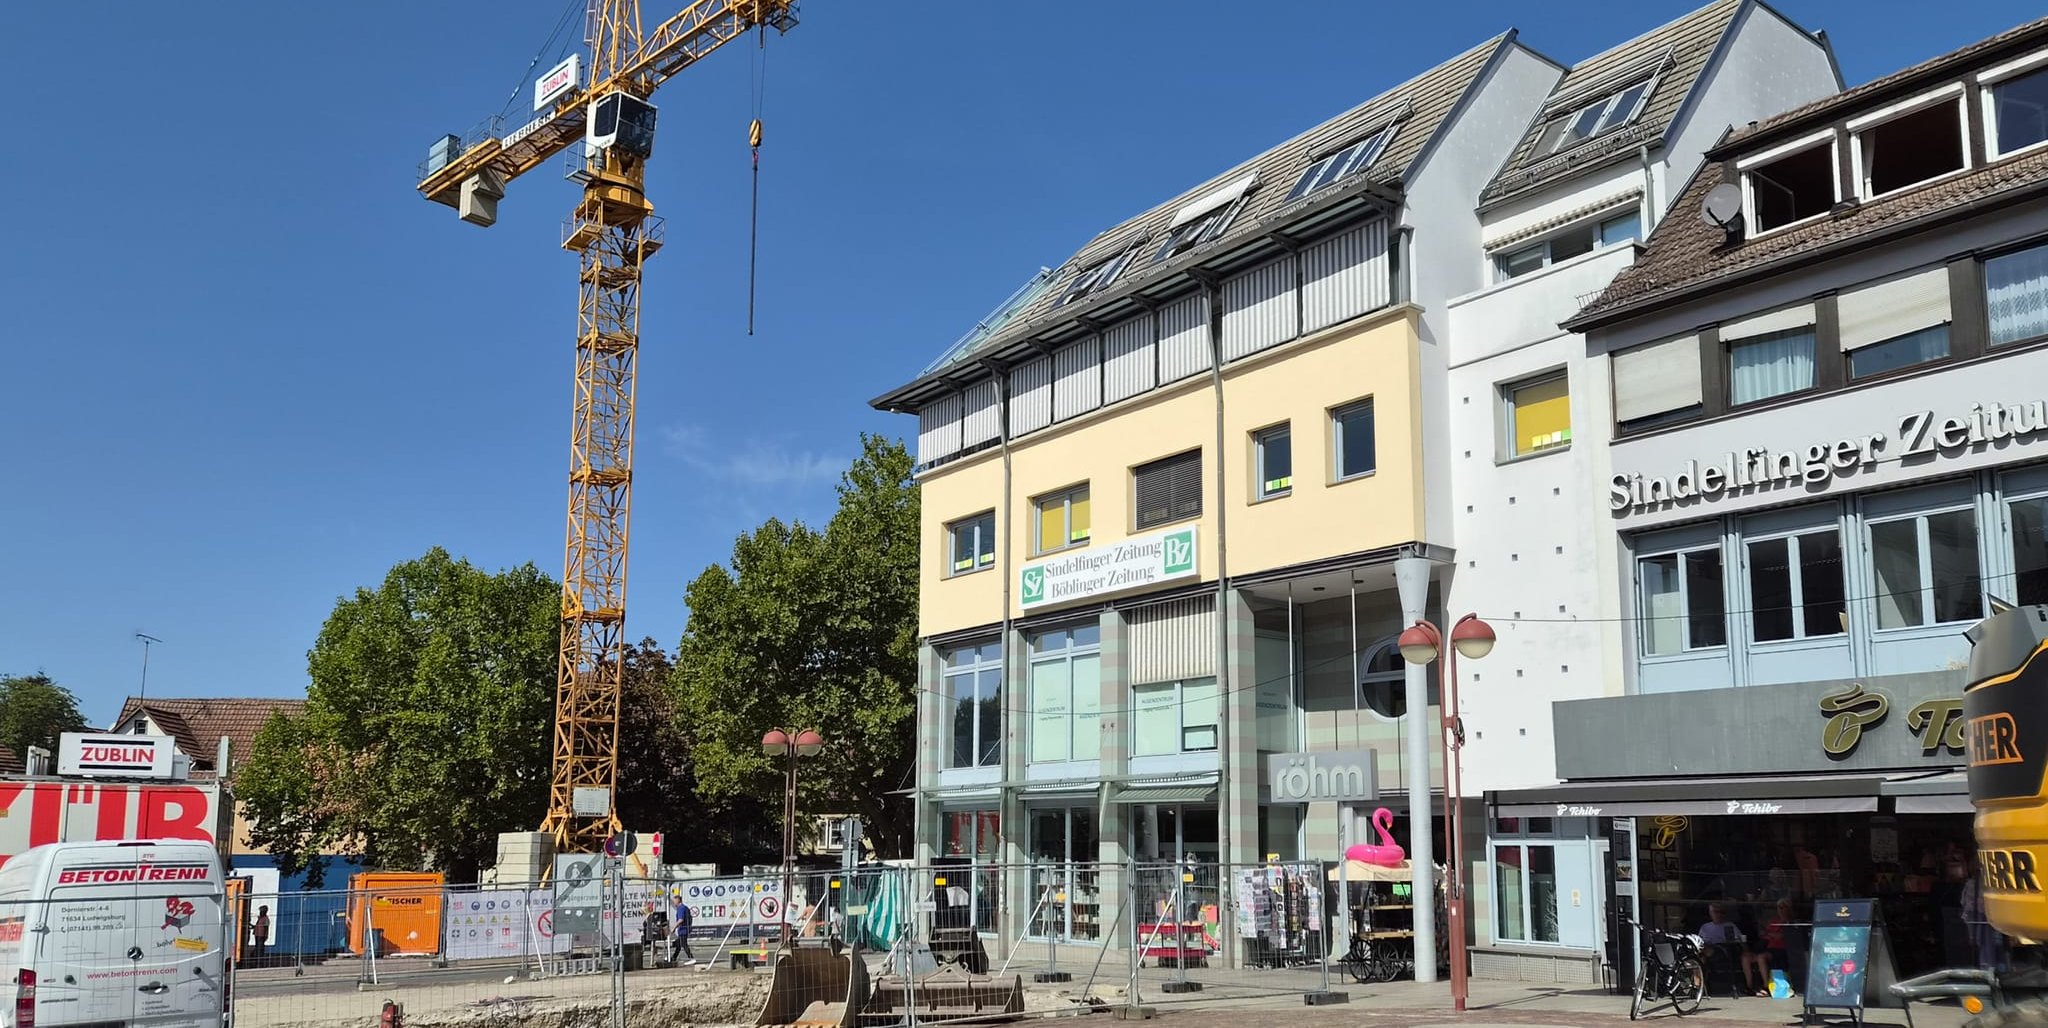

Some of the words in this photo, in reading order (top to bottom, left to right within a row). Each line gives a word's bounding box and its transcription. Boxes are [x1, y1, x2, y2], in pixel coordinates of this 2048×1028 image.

[1609, 432, 1887, 512] Sindelfinger
[1045, 553, 1113, 579] Sindelfinger
[1115, 541, 1162, 564] Zeitung
[1052, 574, 1105, 598] Böblinger
[1108, 567, 1155, 587] Zeitung
[80, 746, 155, 763] ZÜBLIN
[1276, 755, 1365, 799] röhm
[1569, 805, 1602, 816] Tchibo
[1741, 802, 1783, 814] Tchibo
[58, 864, 209, 884] BETONTRENN
[82, 914, 125, 922] Ludwigsburg
[86, 966, 178, 980] www.betontrenn.com
